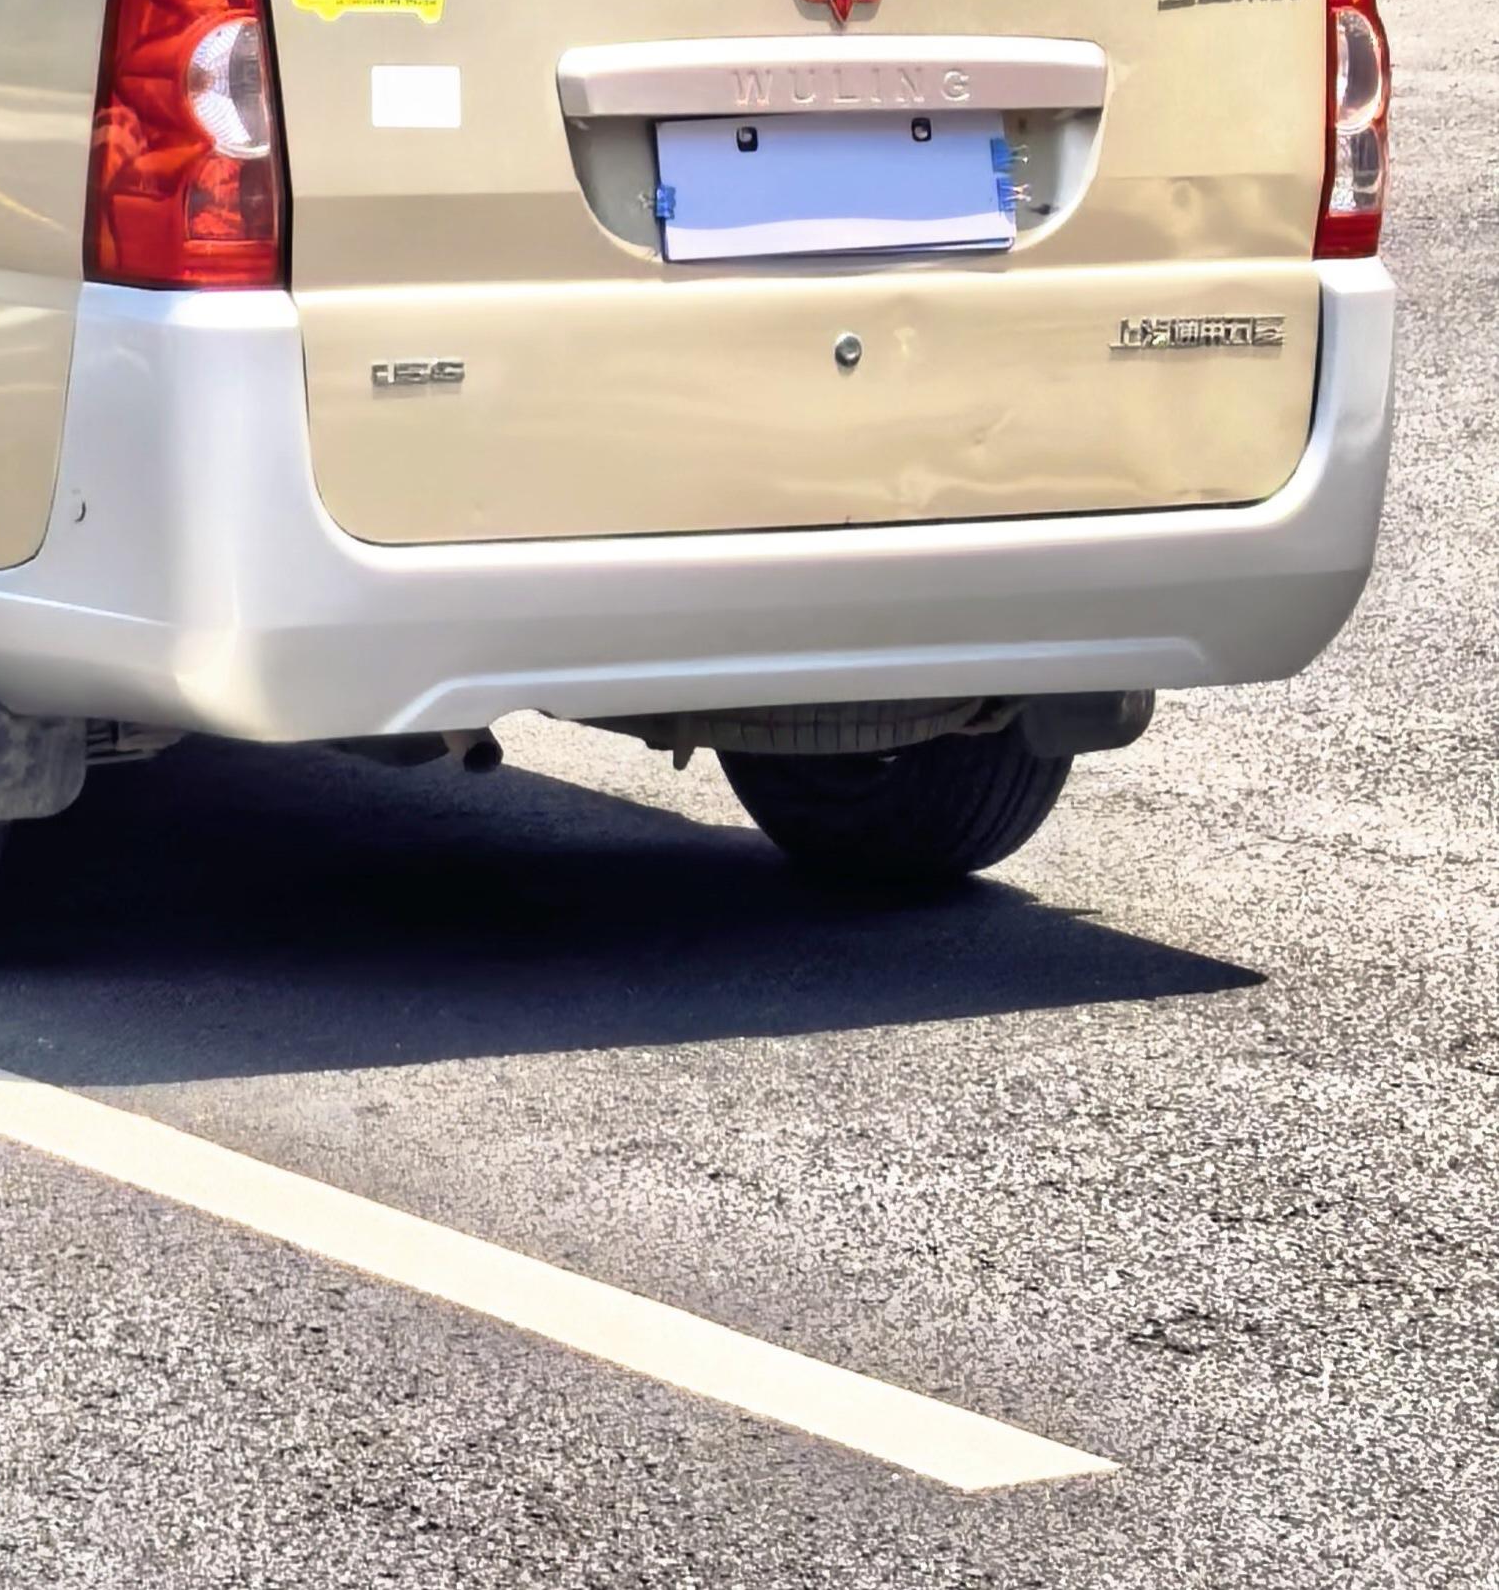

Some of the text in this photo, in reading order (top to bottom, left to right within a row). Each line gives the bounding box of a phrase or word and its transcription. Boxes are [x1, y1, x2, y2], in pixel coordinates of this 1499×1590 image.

[731, 66, 972, 107] WULING
[1108, 314, 1287, 350] 上汽通用五菱
